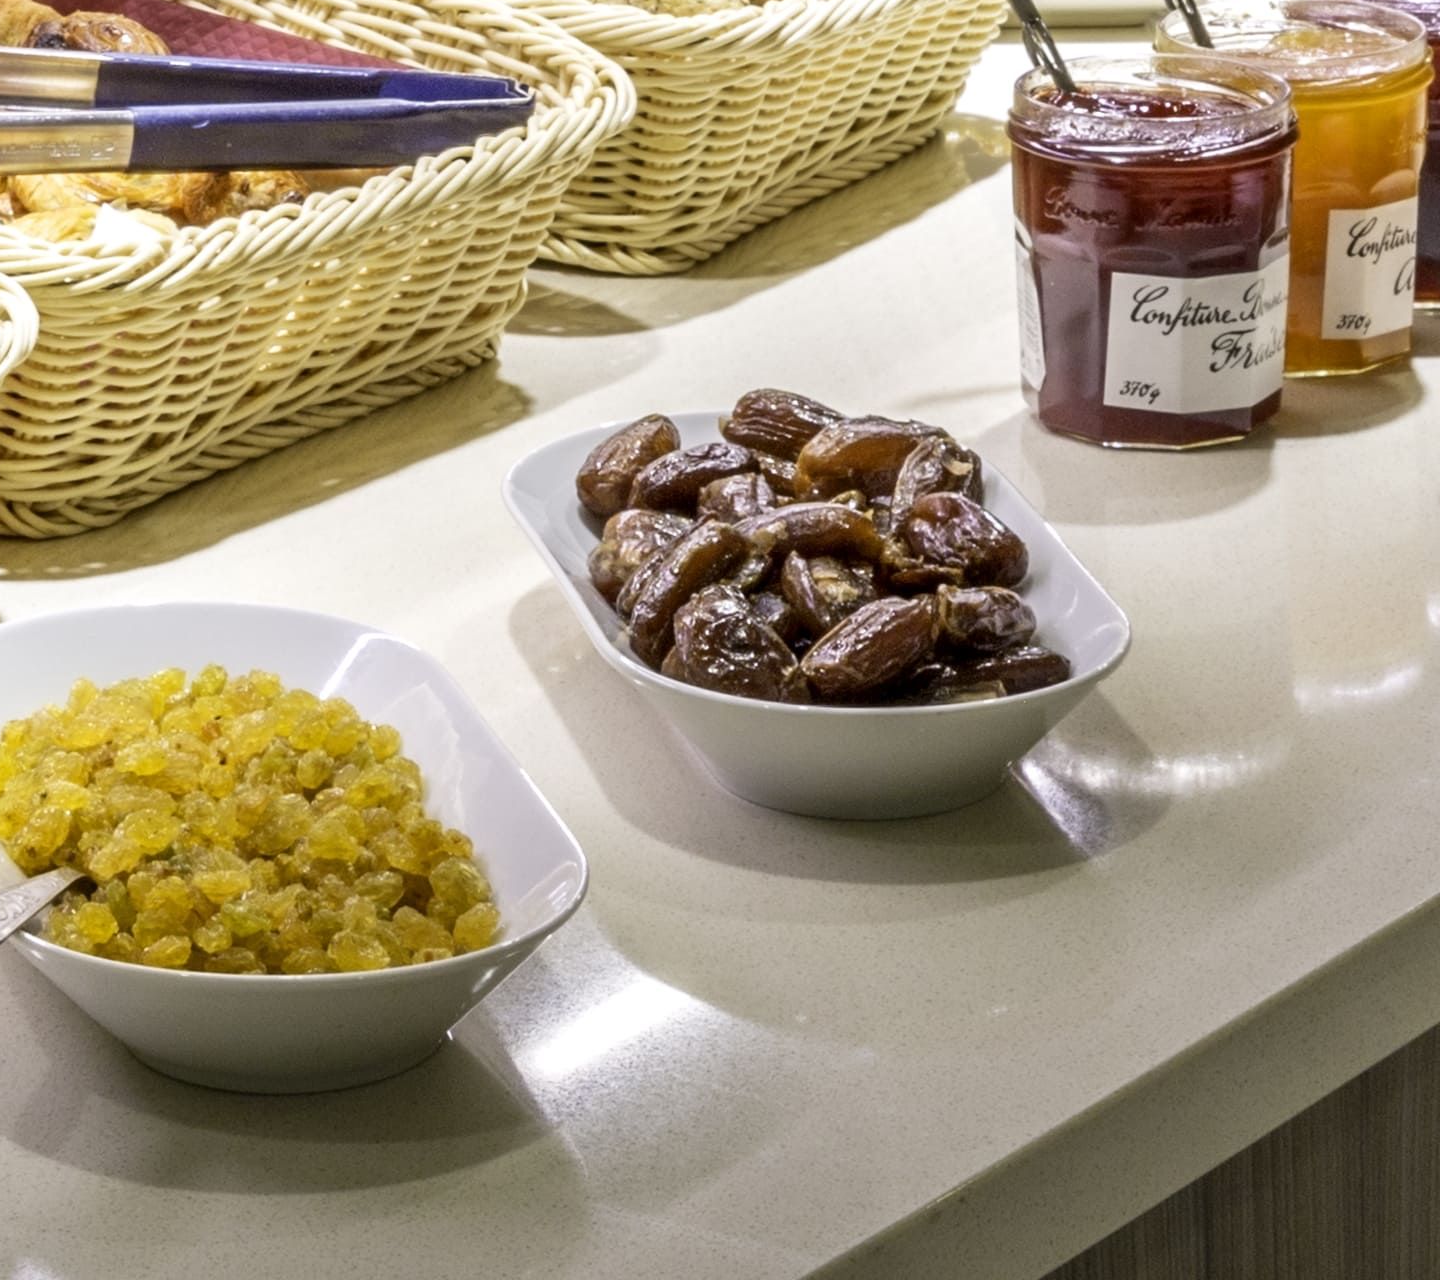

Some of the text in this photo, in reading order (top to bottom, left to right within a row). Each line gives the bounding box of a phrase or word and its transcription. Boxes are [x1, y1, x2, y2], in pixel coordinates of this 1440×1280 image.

[1129, 284, 1238, 336] Confiture
[1335, 313, 1372, 335] 370g
[1119, 379, 1161, 405] 370g
